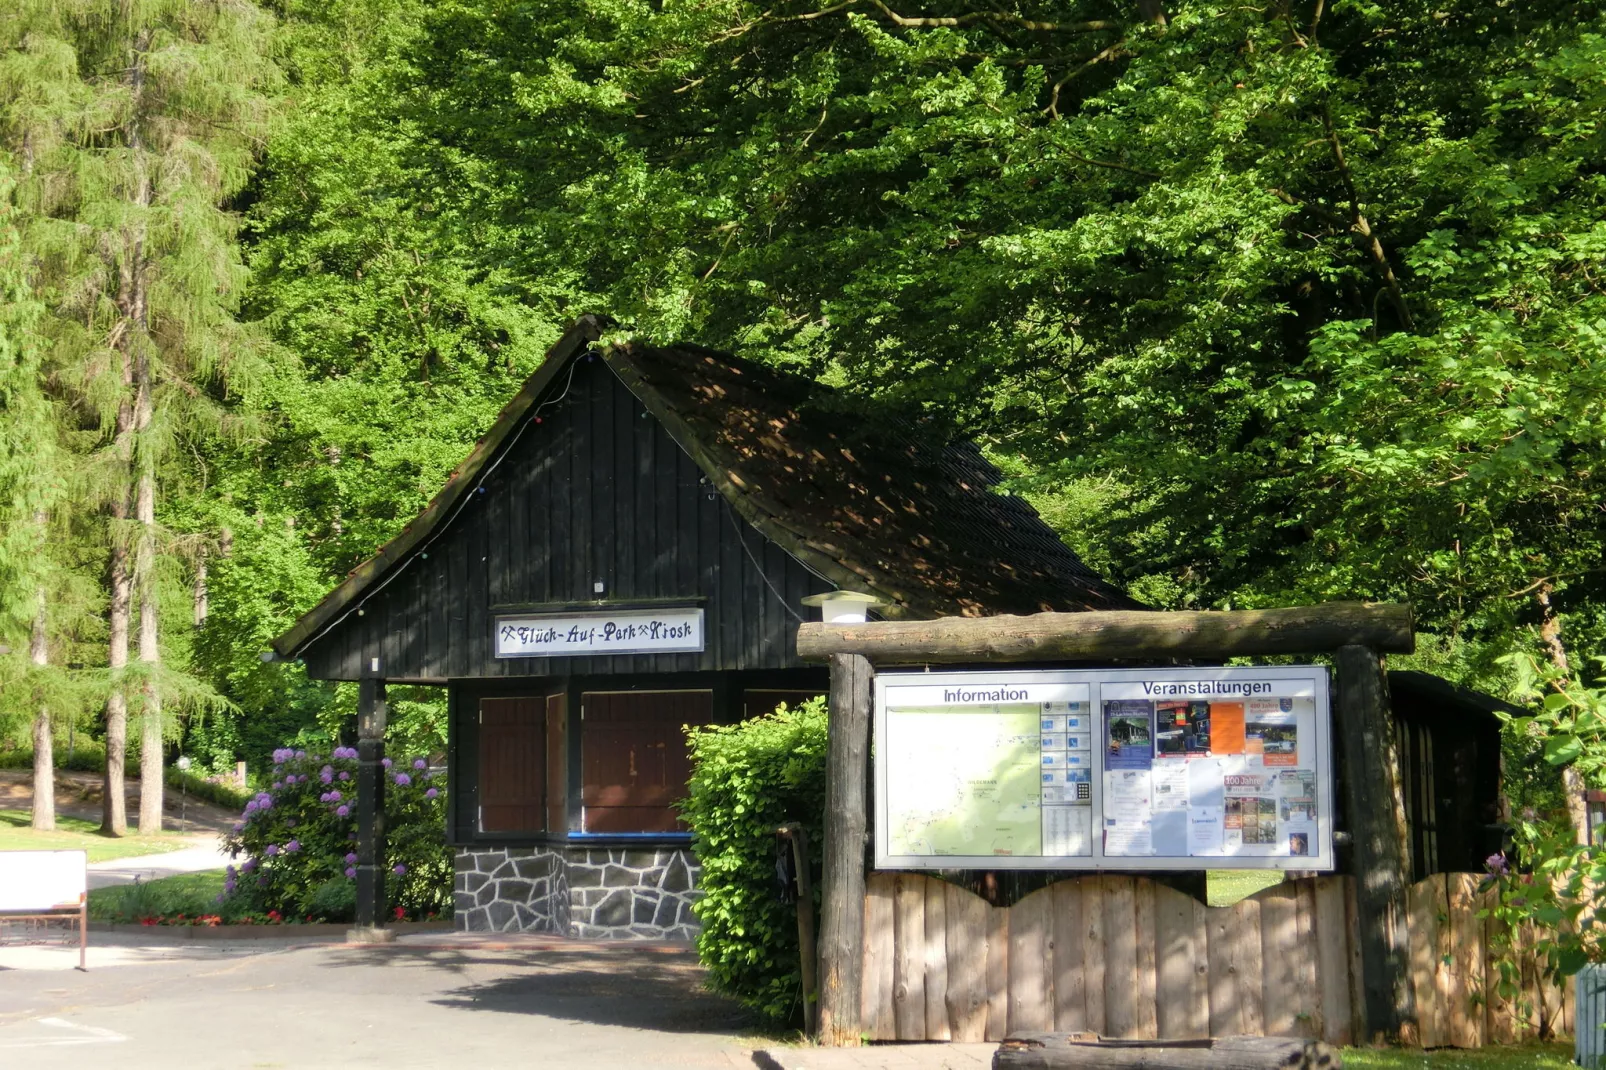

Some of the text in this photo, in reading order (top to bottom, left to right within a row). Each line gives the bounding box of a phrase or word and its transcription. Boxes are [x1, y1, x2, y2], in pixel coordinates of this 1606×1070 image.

[650, 620, 692, 640] Kiosk
[944, 688, 1028, 702] Information
[1143, 680, 1272, 697] Veranstaltungen
[1226, 776, 1261, 785] 100 Jahre
